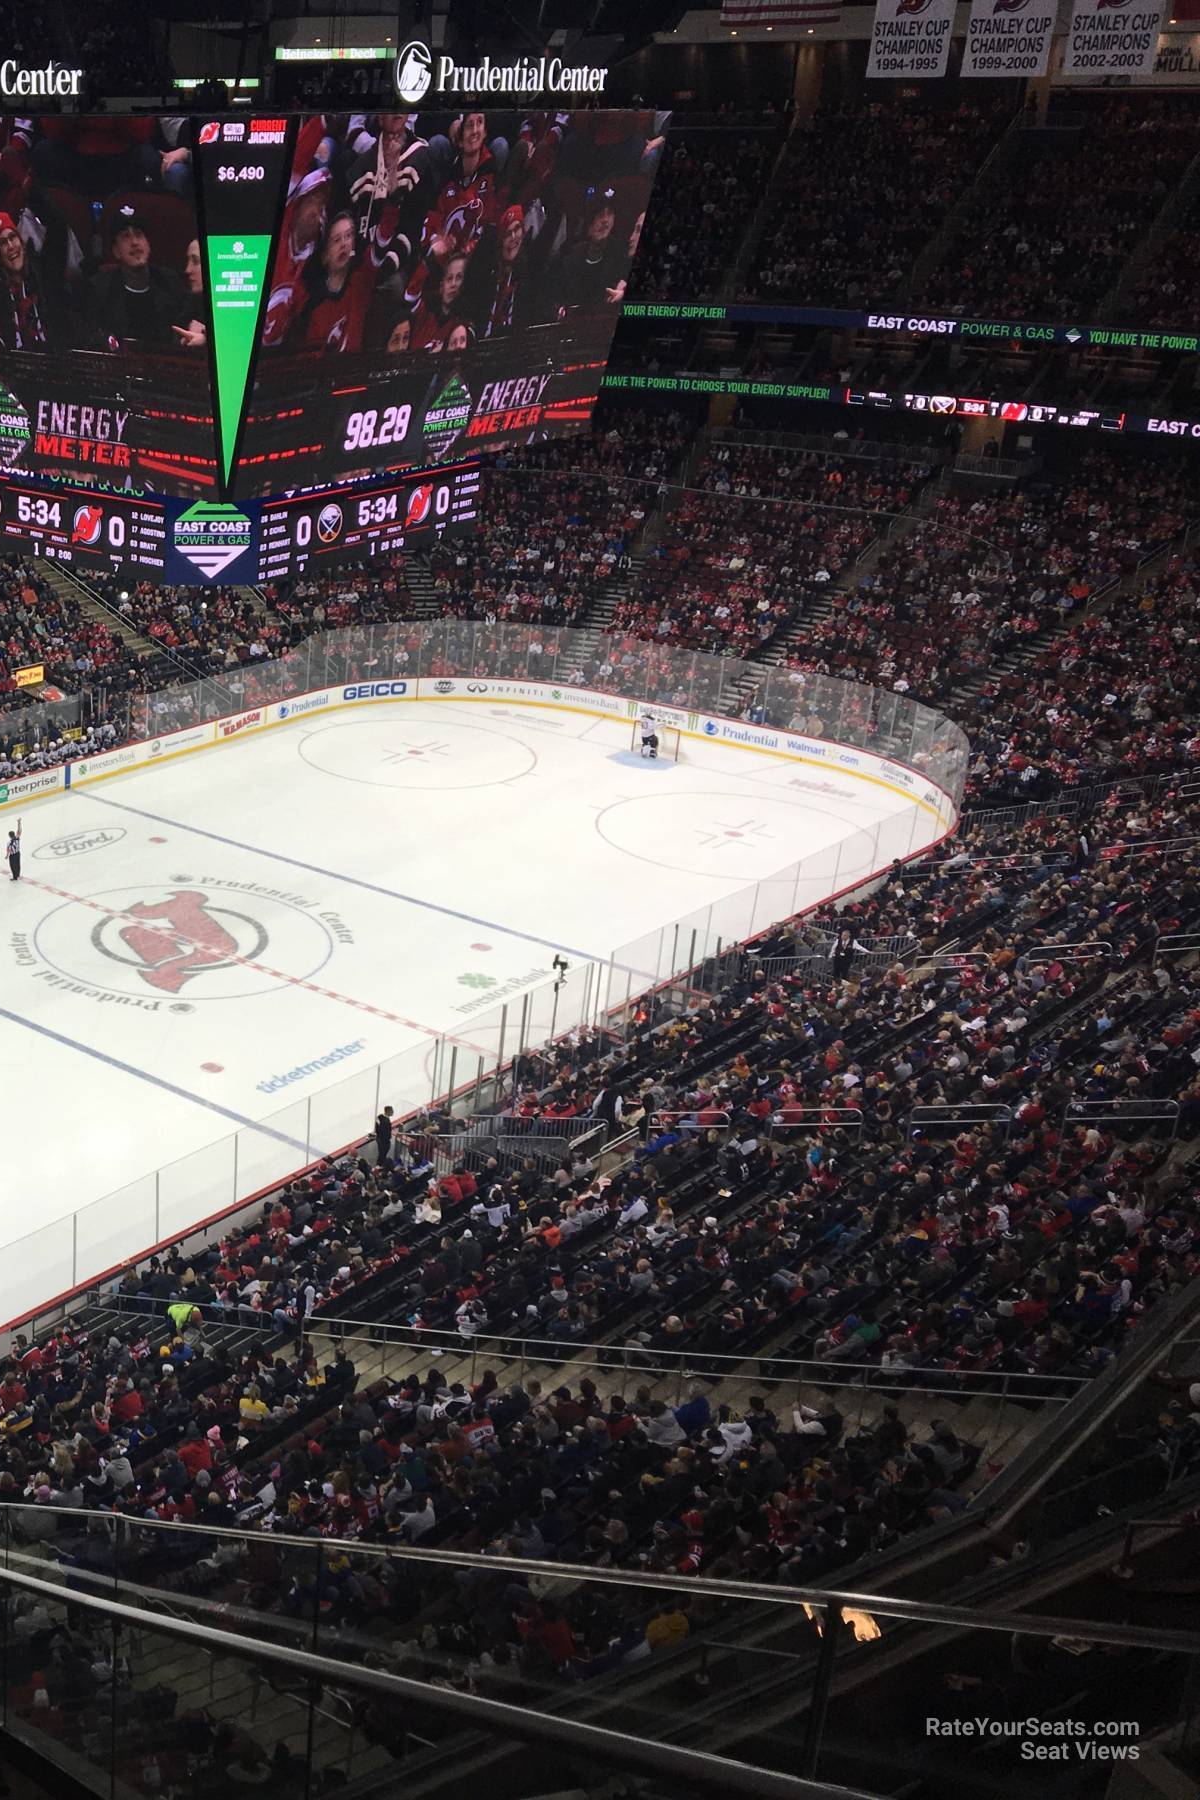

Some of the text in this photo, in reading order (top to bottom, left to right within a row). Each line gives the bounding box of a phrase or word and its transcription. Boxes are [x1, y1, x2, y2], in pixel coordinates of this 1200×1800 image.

[874, 20, 951, 37] STANLEY CUP
[970, 16, 1051, 35] STANLEY CUP
[1073, 13, 1160, 31] STANLEY CUP
[875, 38, 943, 55] CHAMPIONS
[971, 37, 1044, 53] CHAMPIONS
[1073, 33, 1151, 51] CHAMPIONS
[875, 57, 938, 70] 1994-1995
[971, 56, 1038, 69] 1999-2000
[1073, 53, 1144, 67] 2002-2003
[0, 60, 83, 96] Center
[437, 56, 608, 92] Prudential Center
[250, 119, 288, 132] CURRENT
[247, 131, 285, 144] JACKPOT
[217, 165, 265, 182] $6,490
[623, 304, 726, 319] YOUR ENERGY SUPPLIER!
[867, 315, 1055, 341] EAST COAST POWER & GAS
[1089, 330, 1198, 351] YOU HAVE THE POWER
[476, 373, 552, 414] ENERGY
[605, 376, 830, 400] HAVE THE POWER TO CHOOSE YOUR ENERGY SUPPLIER!
[916, 397, 926, 409] 0
[963, 402, 985, 413] 5:34
[0, 412, 29, 426] COAST
[36, 400, 129, 443] ENERGY
[425, 404, 471, 422] EAST COAST
[465, 405, 542, 438] METER
[1032, 407, 1041, 419] 0
[7, 427, 13, 436] &
[14, 427, 31, 439] GAS
[422, 421, 448, 434] POWER
[453, 417, 468, 428] GAS
[1146, 418, 1189, 435] EAST
[35, 431, 131, 468] METER
[435, 485, 450, 515] 0
[18, 495, 61, 528] 5:34
[140, 512, 165, 525] LOVEJOY
[358, 494, 398, 526] 5:34
[108, 515, 125, 547] 0
[174, 521, 252, 533] EAST COAST
[296, 515, 312, 547] 0
[33, 542, 39, 556] 1
[174, 535, 251, 545] POWER & GAS
[370, 541, 376, 556] 1
[113, 563, 119, 573] 7
[343, 682, 407, 701] GEICO
[491, 684, 544, 697] INFINITI
[291, 694, 329, 714] Prudential
[722, 726, 779, 748] Prudential
[786, 738, 826, 757] Walmart
[50, 832, 114, 856] Ford
[200, 876, 355, 946] Prudential Center
[7, 931, 161, 1012] Prudential Center
[256, 1039, 366, 1094] ticketmaster
